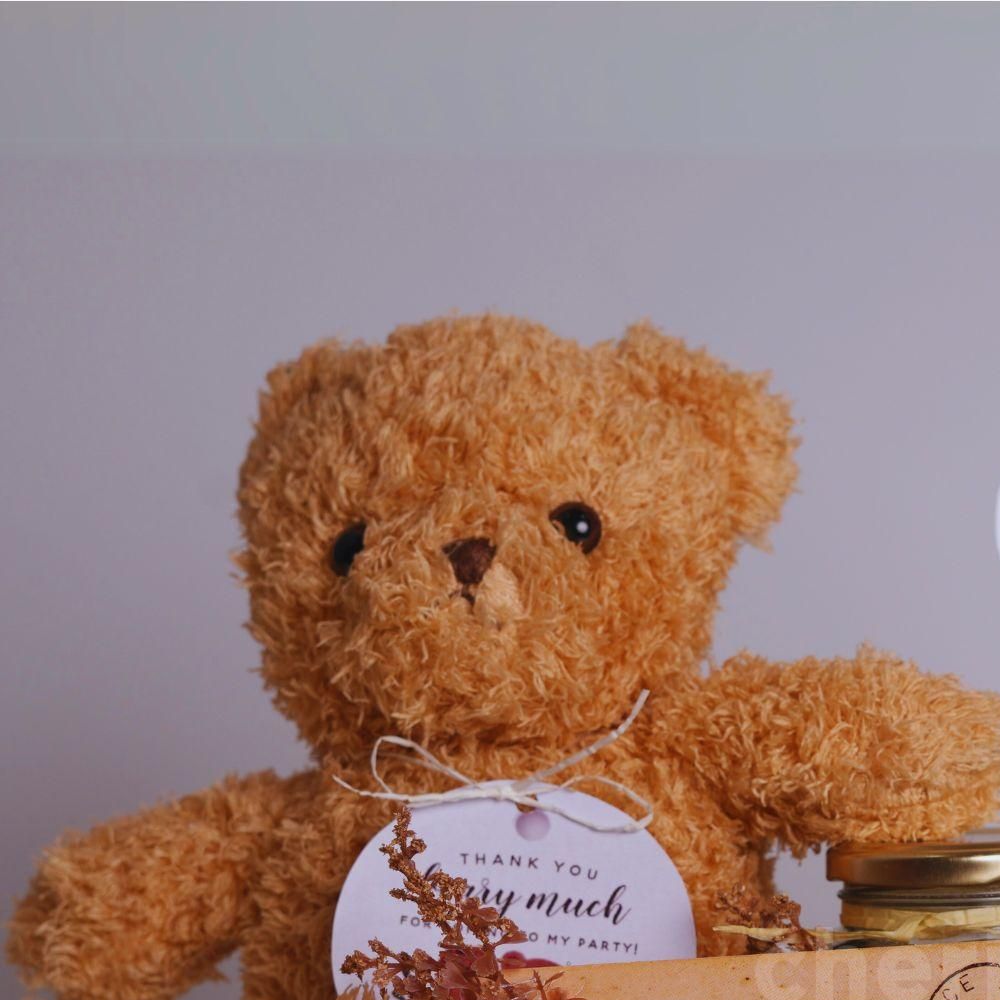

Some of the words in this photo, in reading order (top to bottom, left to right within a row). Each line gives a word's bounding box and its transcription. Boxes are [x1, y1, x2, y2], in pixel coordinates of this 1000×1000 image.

[460, 853, 539, 870] THANK
[553, 859, 599, 881] YOU
[524, 884, 634, 926] much
[546, 934, 571, 947] MY
[577, 937, 640, 956] PARTY!
